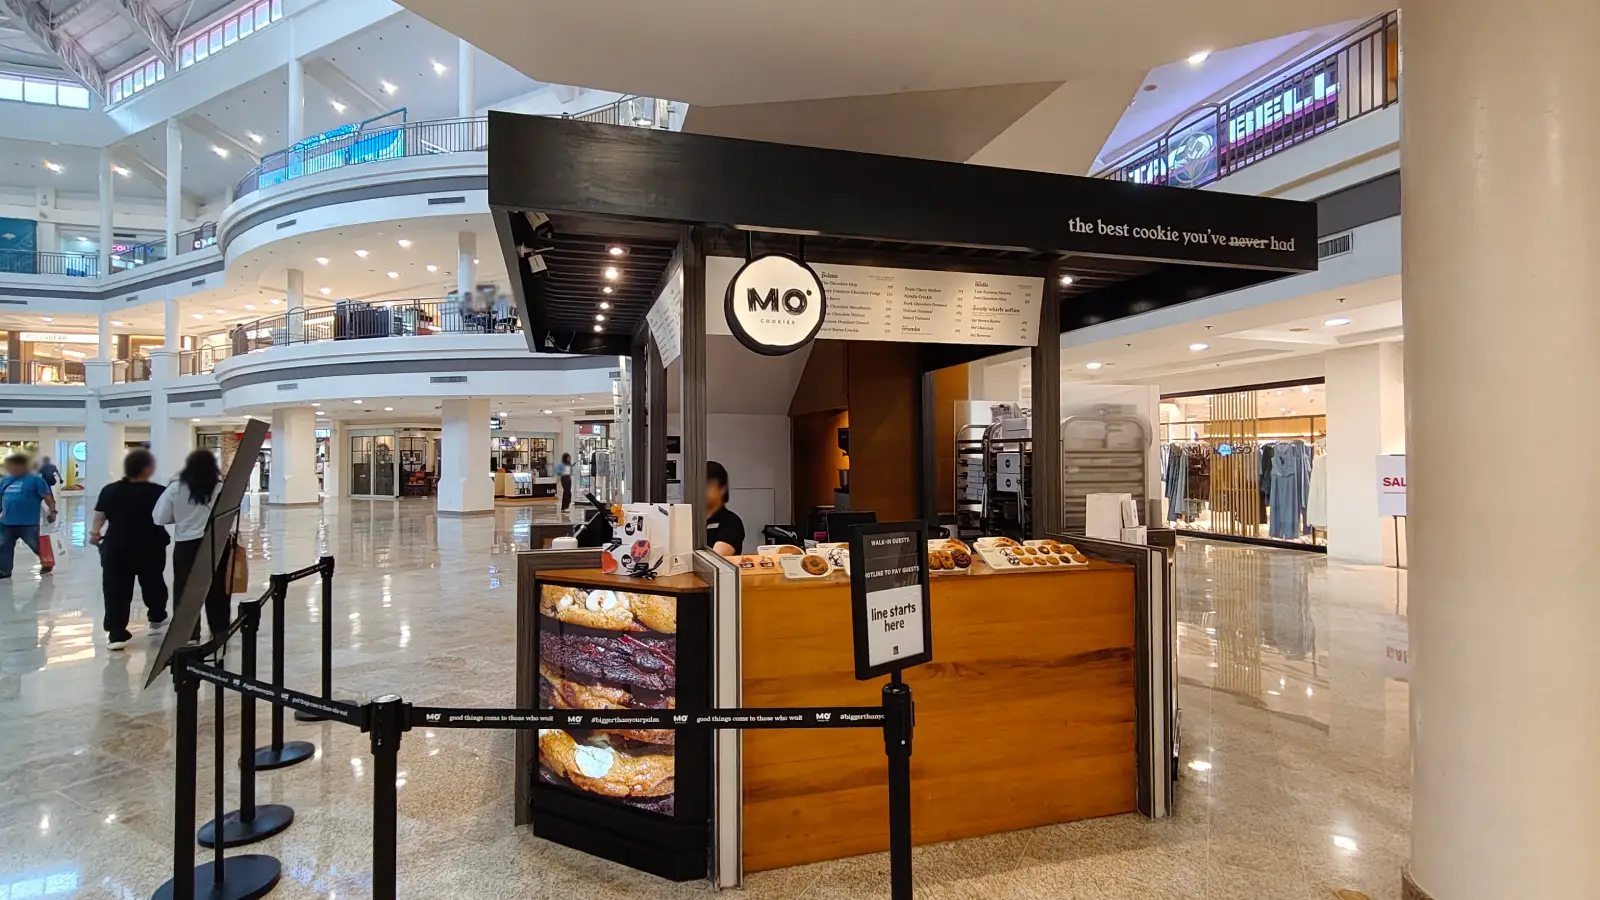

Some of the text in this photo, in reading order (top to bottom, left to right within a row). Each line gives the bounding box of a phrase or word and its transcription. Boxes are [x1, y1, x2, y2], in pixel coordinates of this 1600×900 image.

[1228, 72, 1341, 143] BELL
[1068, 217, 1296, 252] the best cookie you've never had
[1383, 477, 1407, 487] SAL
[871, 536, 910, 547] WALK-IN GUESTS
[902, 565, 920, 574] GUESTS
[871, 602, 916, 621] line starts
[884, 619, 905, 632] here
[591, 716, 660, 724] #biggerthanyourpalm
[696, 715, 711, 723] good
